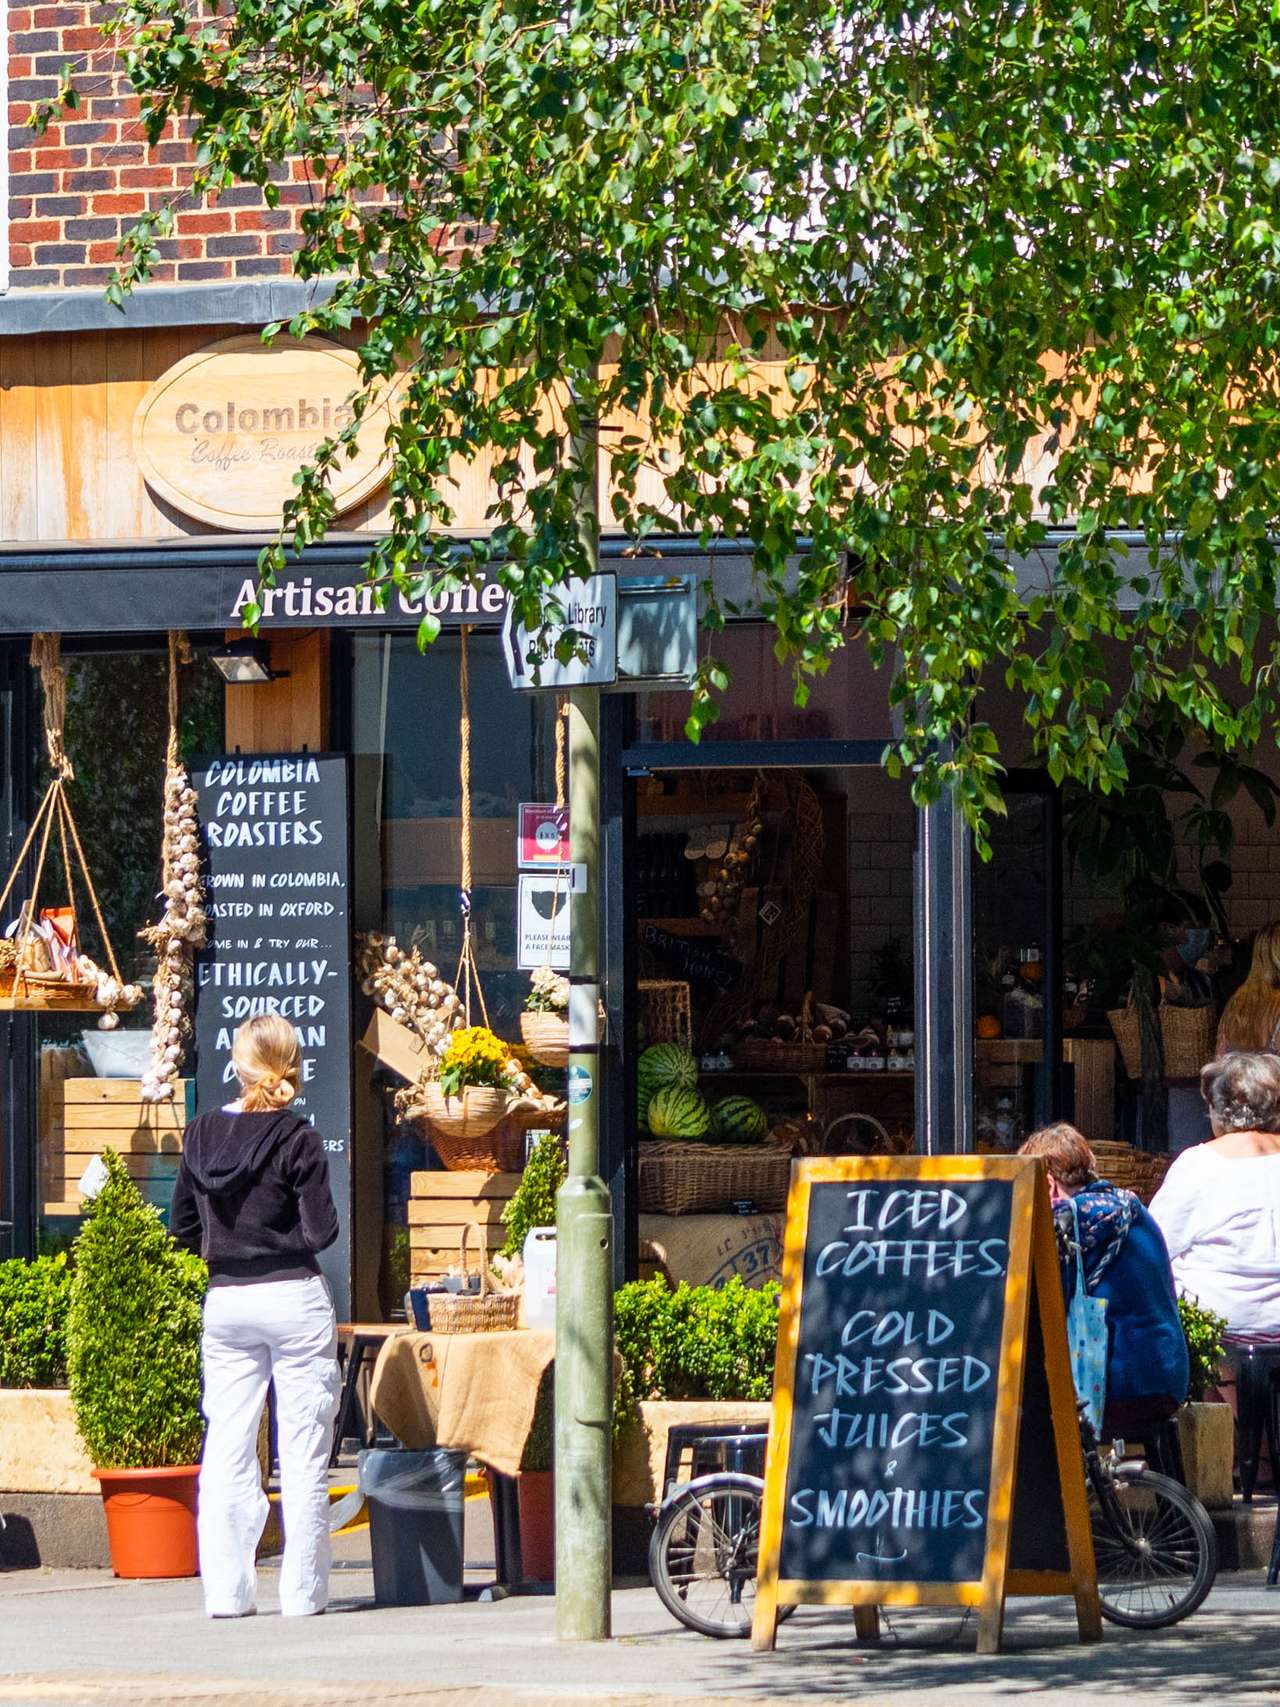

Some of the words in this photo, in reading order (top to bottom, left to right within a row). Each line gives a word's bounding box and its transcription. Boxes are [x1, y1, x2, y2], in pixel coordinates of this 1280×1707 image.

[175, 397, 353, 434] Colombia
[191, 439, 250, 471] Coffee
[230, 577, 387, 617] Artisan
[568, 602, 607, 628] Library
[205, 758, 320, 787] COLOMBIA
[216, 790, 308, 817] COFFEE
[207, 820, 323, 847] ROASTERS
[252, 873, 265, 888] IN
[205, 902, 254, 917] OASTED
[259, 903, 273, 917] IN
[237, 939, 249, 949] IN
[253, 937, 263, 949] &
[269, 938, 290, 949] TRY
[199, 959, 338, 987] ETHICALLY-
[222, 995, 325, 1018] SOURCED
[843, 1188, 968, 1231] ICED
[841, 1309, 955, 1347] COLD
[804, 1353, 992, 1395] PRESSED
[813, 1408, 969, 1449] JUICES
[884, 1459, 898, 1478] &
[790, 1487, 985, 1529] SMOOTHIES
